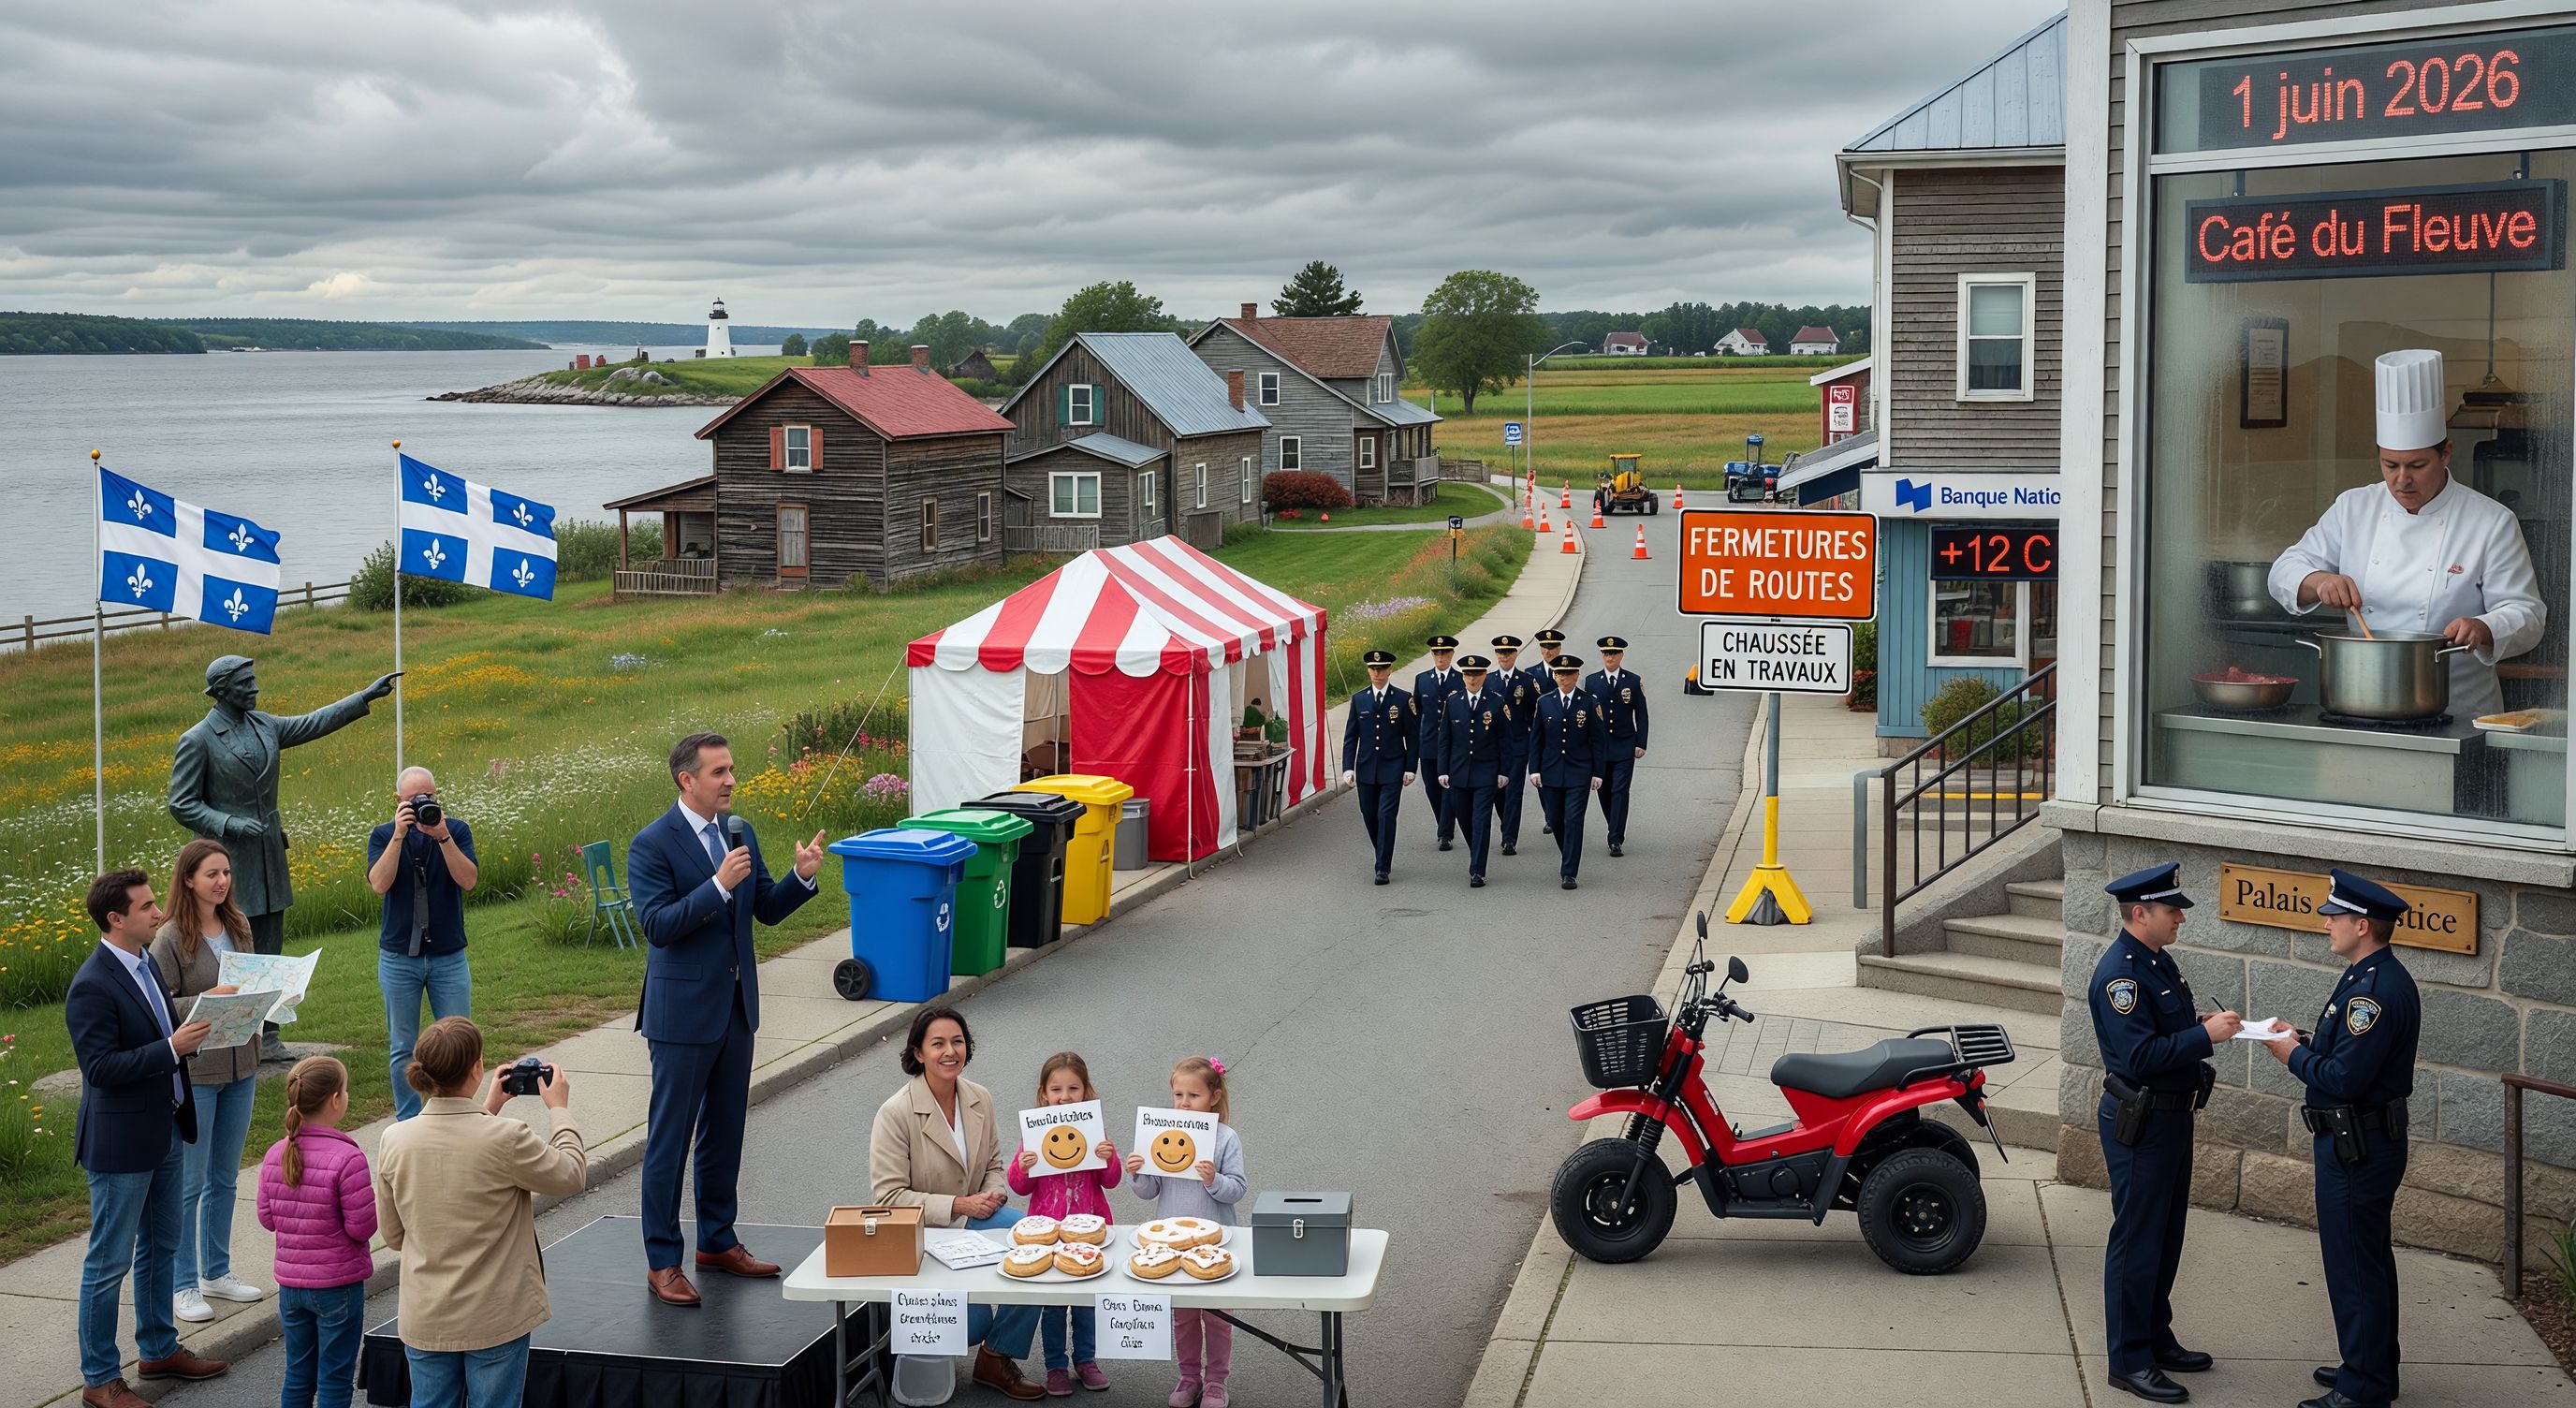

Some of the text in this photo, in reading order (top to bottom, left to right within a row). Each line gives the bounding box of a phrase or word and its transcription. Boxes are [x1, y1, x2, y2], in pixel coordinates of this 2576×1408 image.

[2232, 51, 2520, 140] 1 juin 2026
[2198, 204, 2537, 262] Café du Fleuve
[1940, 487, 2061, 508] Banque Natio
[1690, 527, 1866, 560] FERMETURES
[1940, 535, 2051, 572] +12 C
[1701, 568, 1854, 602] DE ROUTES
[1722, 628, 1827, 656] CHAUSSÉE
[1711, 658, 1837, 683] EN TRAVAUX
[2235, 879, 2313, 915] Palais
